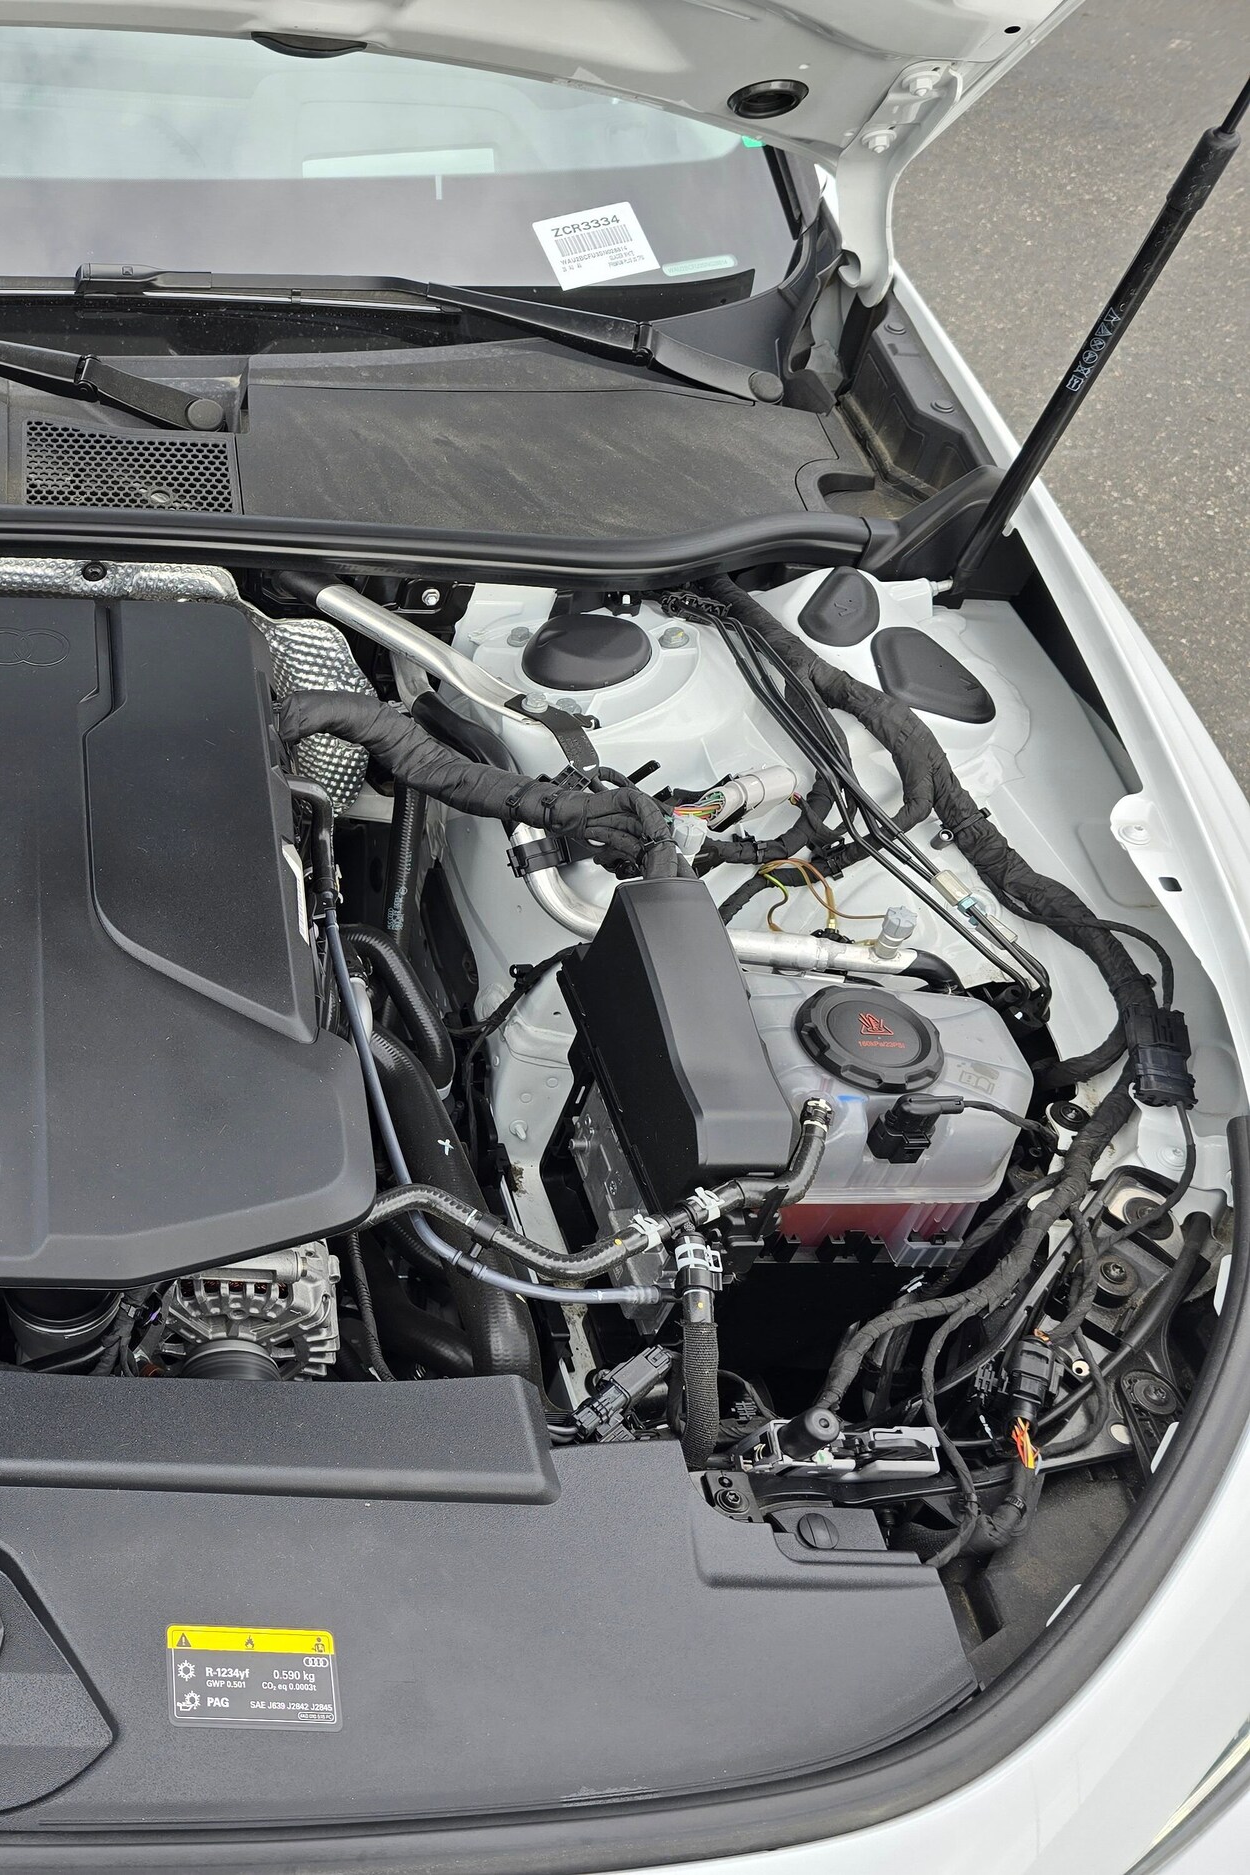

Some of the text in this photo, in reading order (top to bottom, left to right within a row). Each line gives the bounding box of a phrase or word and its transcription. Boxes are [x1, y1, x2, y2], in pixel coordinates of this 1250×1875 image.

[551, 214, 620, 238] ZCR3334
[205, 1666, 250, 1680] R-1234yf
[273, 1669, 315, 1683] 0.590 kg
[206, 1679, 246, 1688] GWP 0.501
[277, 1683, 288, 1692] eq
[288, 1683, 317, 1692] 0.0003t
[206, 1696, 230, 1708] PAG
[250, 1700, 333, 1712] SAE J639 J2842 J2845
